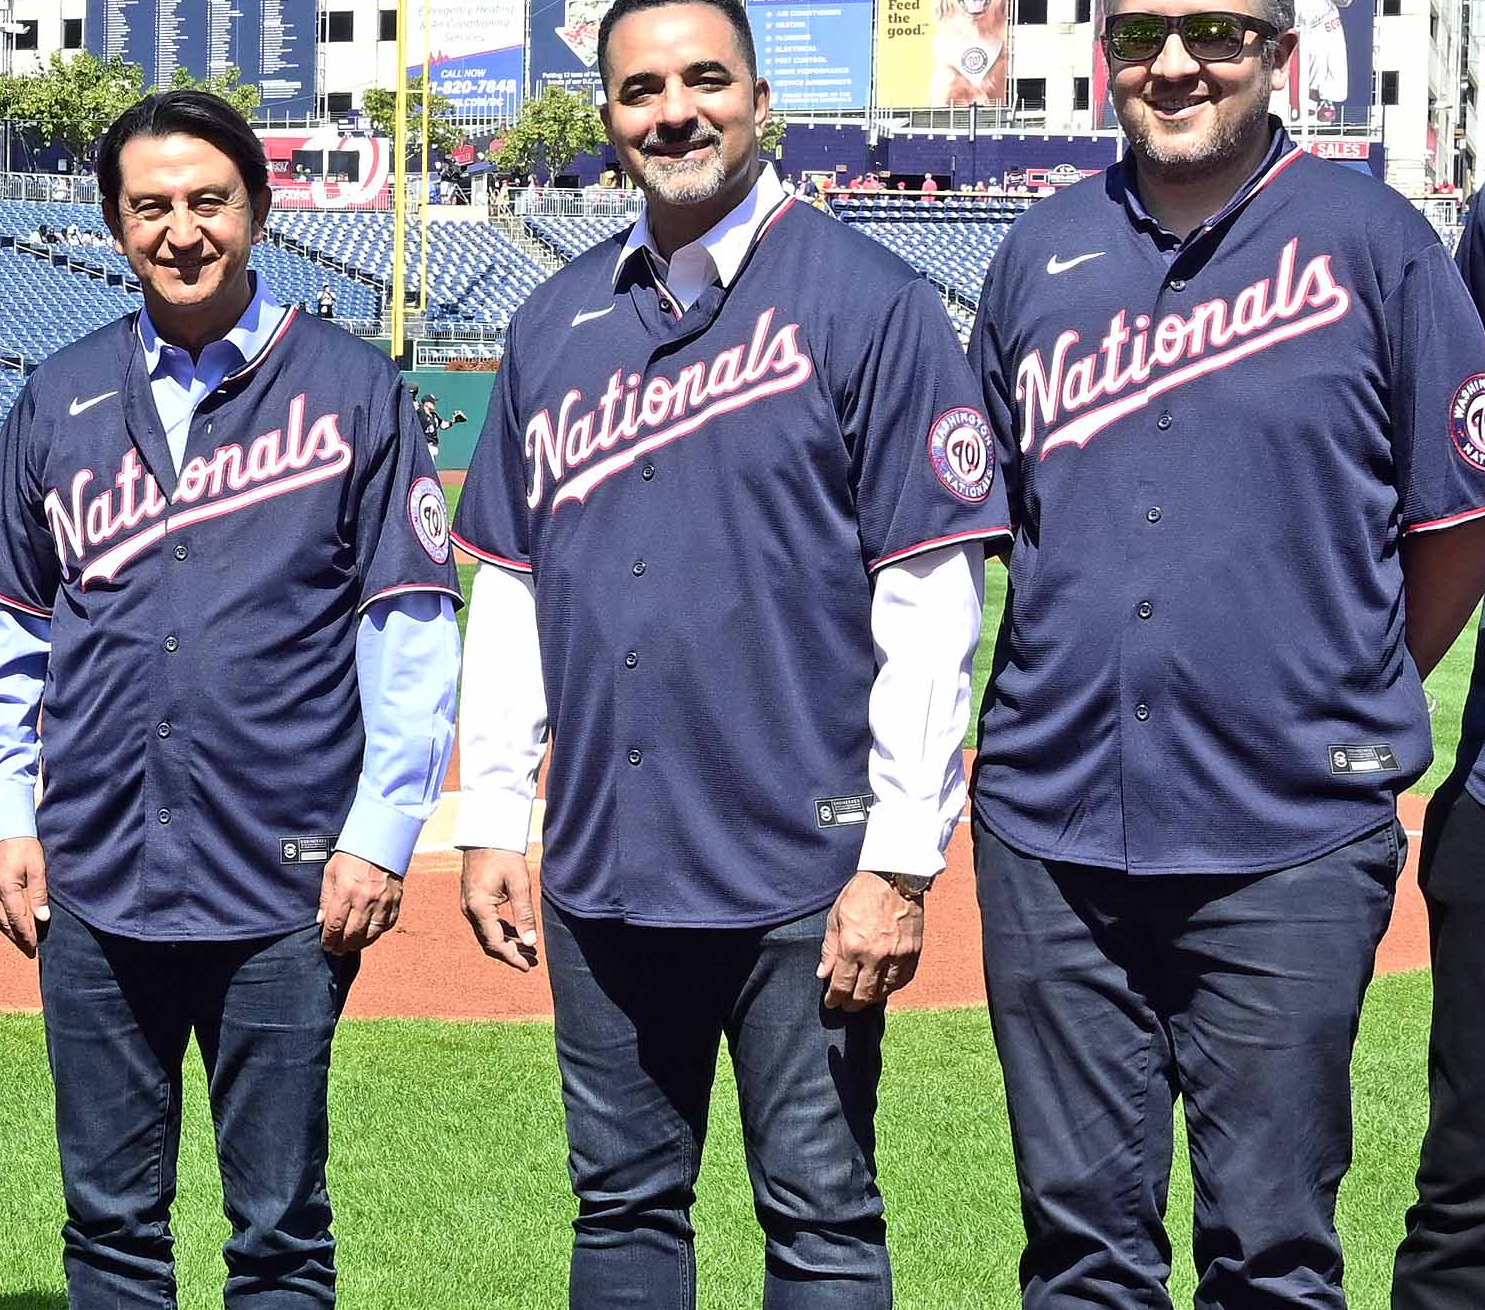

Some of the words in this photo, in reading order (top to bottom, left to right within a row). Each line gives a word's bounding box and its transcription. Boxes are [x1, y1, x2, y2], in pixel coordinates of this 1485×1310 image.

[888, 13, 910, 24] the
[887, 24, 925, 38] good.
[441, 70, 462, 78] CALL
[464, 69, 486, 78] NOW
[1318, 143, 1360, 157] SALES
[1016, 236, 1351, 460] Nationals
[525, 307, 814, 512] Nationals
[43, 393, 353, 589] Nationals
